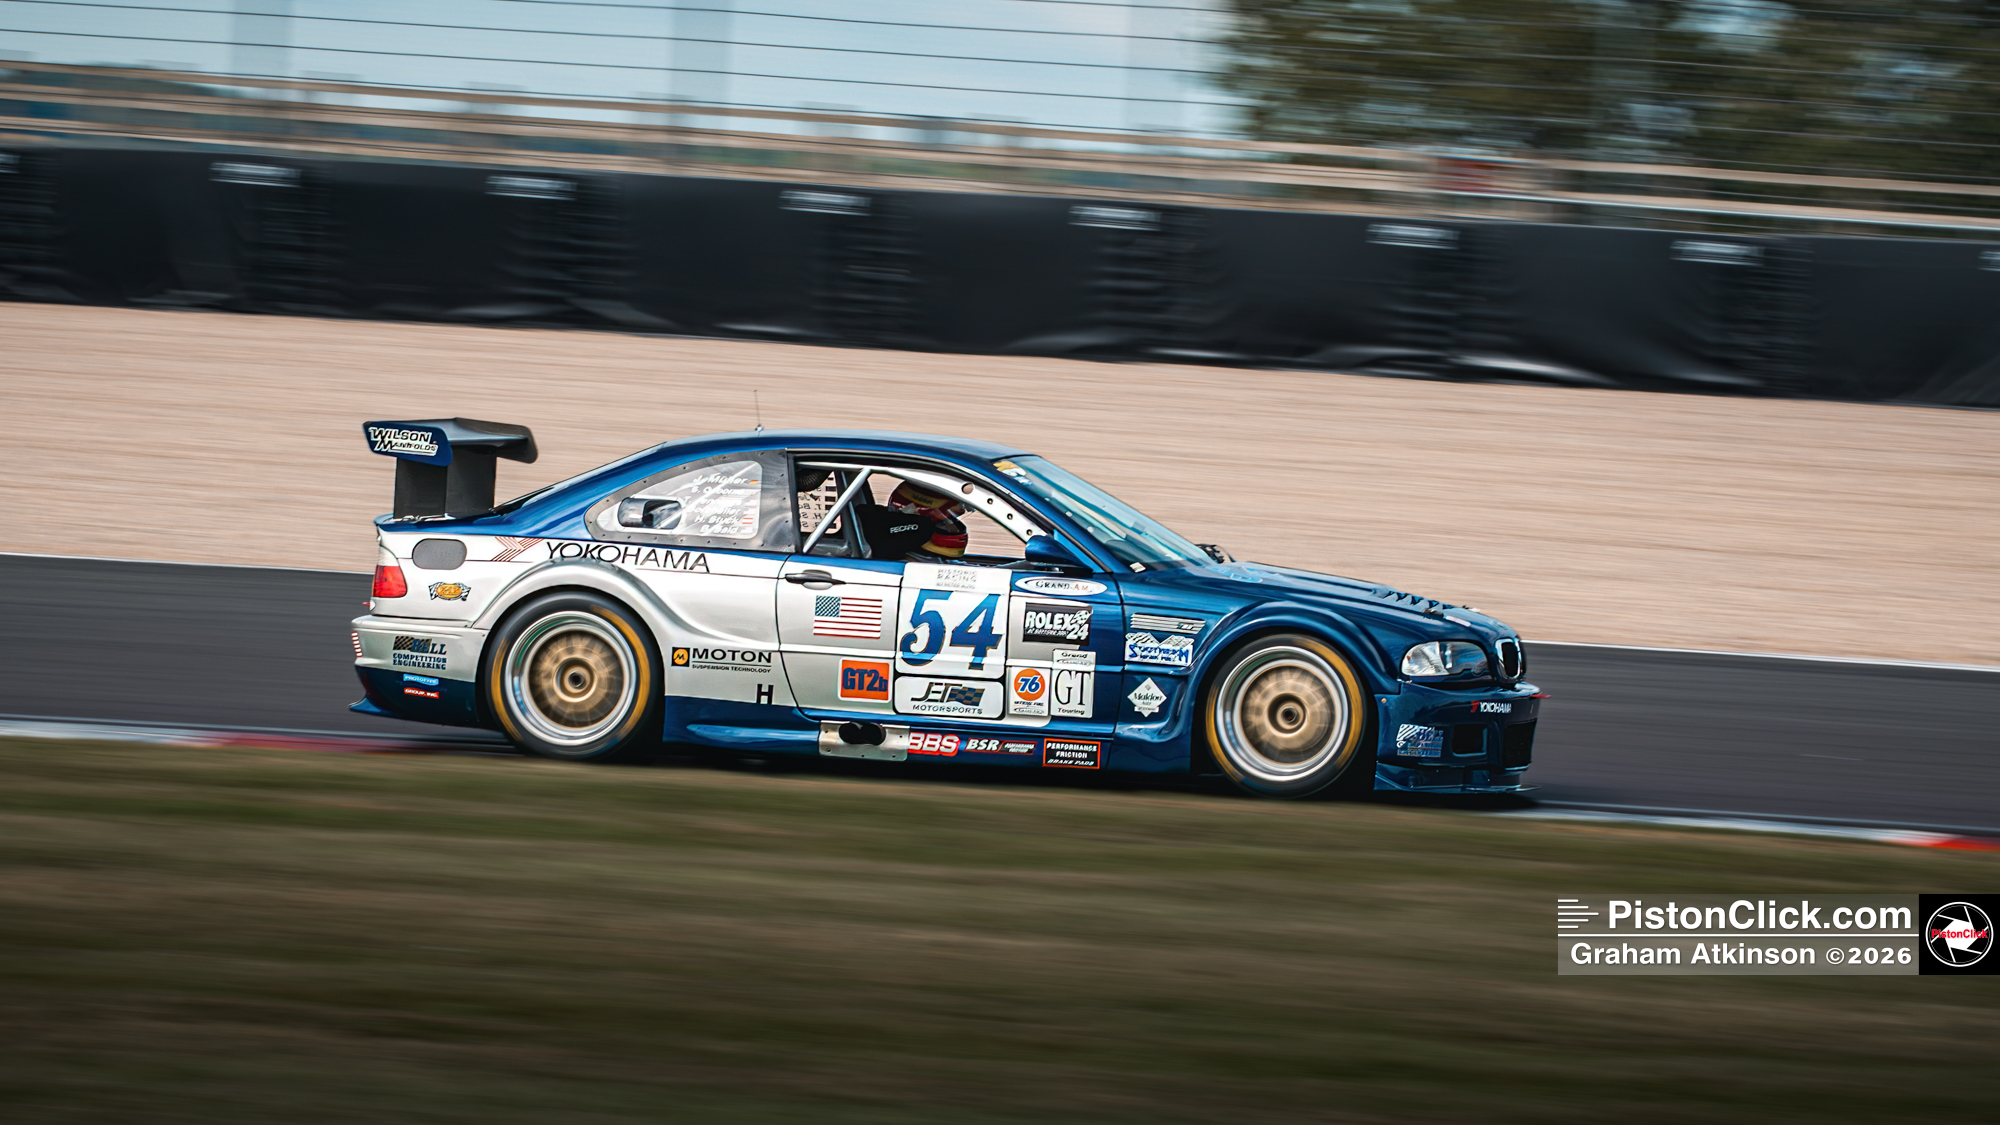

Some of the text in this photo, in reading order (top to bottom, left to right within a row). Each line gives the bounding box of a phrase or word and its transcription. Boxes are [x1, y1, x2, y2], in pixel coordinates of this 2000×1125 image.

[371, 428, 430, 442] WILSON
[890, 524, 918, 533] RECARO
[546, 542, 710, 573] YOKOHAMA
[1025, 611, 1074, 630] ROLEX
[900, 589, 1003, 670] 54
[1066, 624, 1089, 640] 24
[410, 639, 447, 655] BELL
[393, 652, 447, 663] COMPETITION
[692, 648, 771, 663] MOTON
[393, 660, 446, 670] ENGINEERING
[842, 667, 888, 692] GT2b
[1018, 675, 1041, 694] 76
[756, 684, 774, 705] H
[1055, 669, 1091, 706] GT
[913, 704, 983, 714] MOTORSPORTS
[1058, 707, 1085, 715] Touring
[1480, 702, 1512, 713] YOKOHAMA
[908, 732, 959, 753] BBS
[965, 739, 1000, 751] BSR
[1047, 742, 1098, 752] PERFORMANCE
[1047, 758, 1074, 766] BRAKE
[1056, 751, 1088, 759] FRICTION
